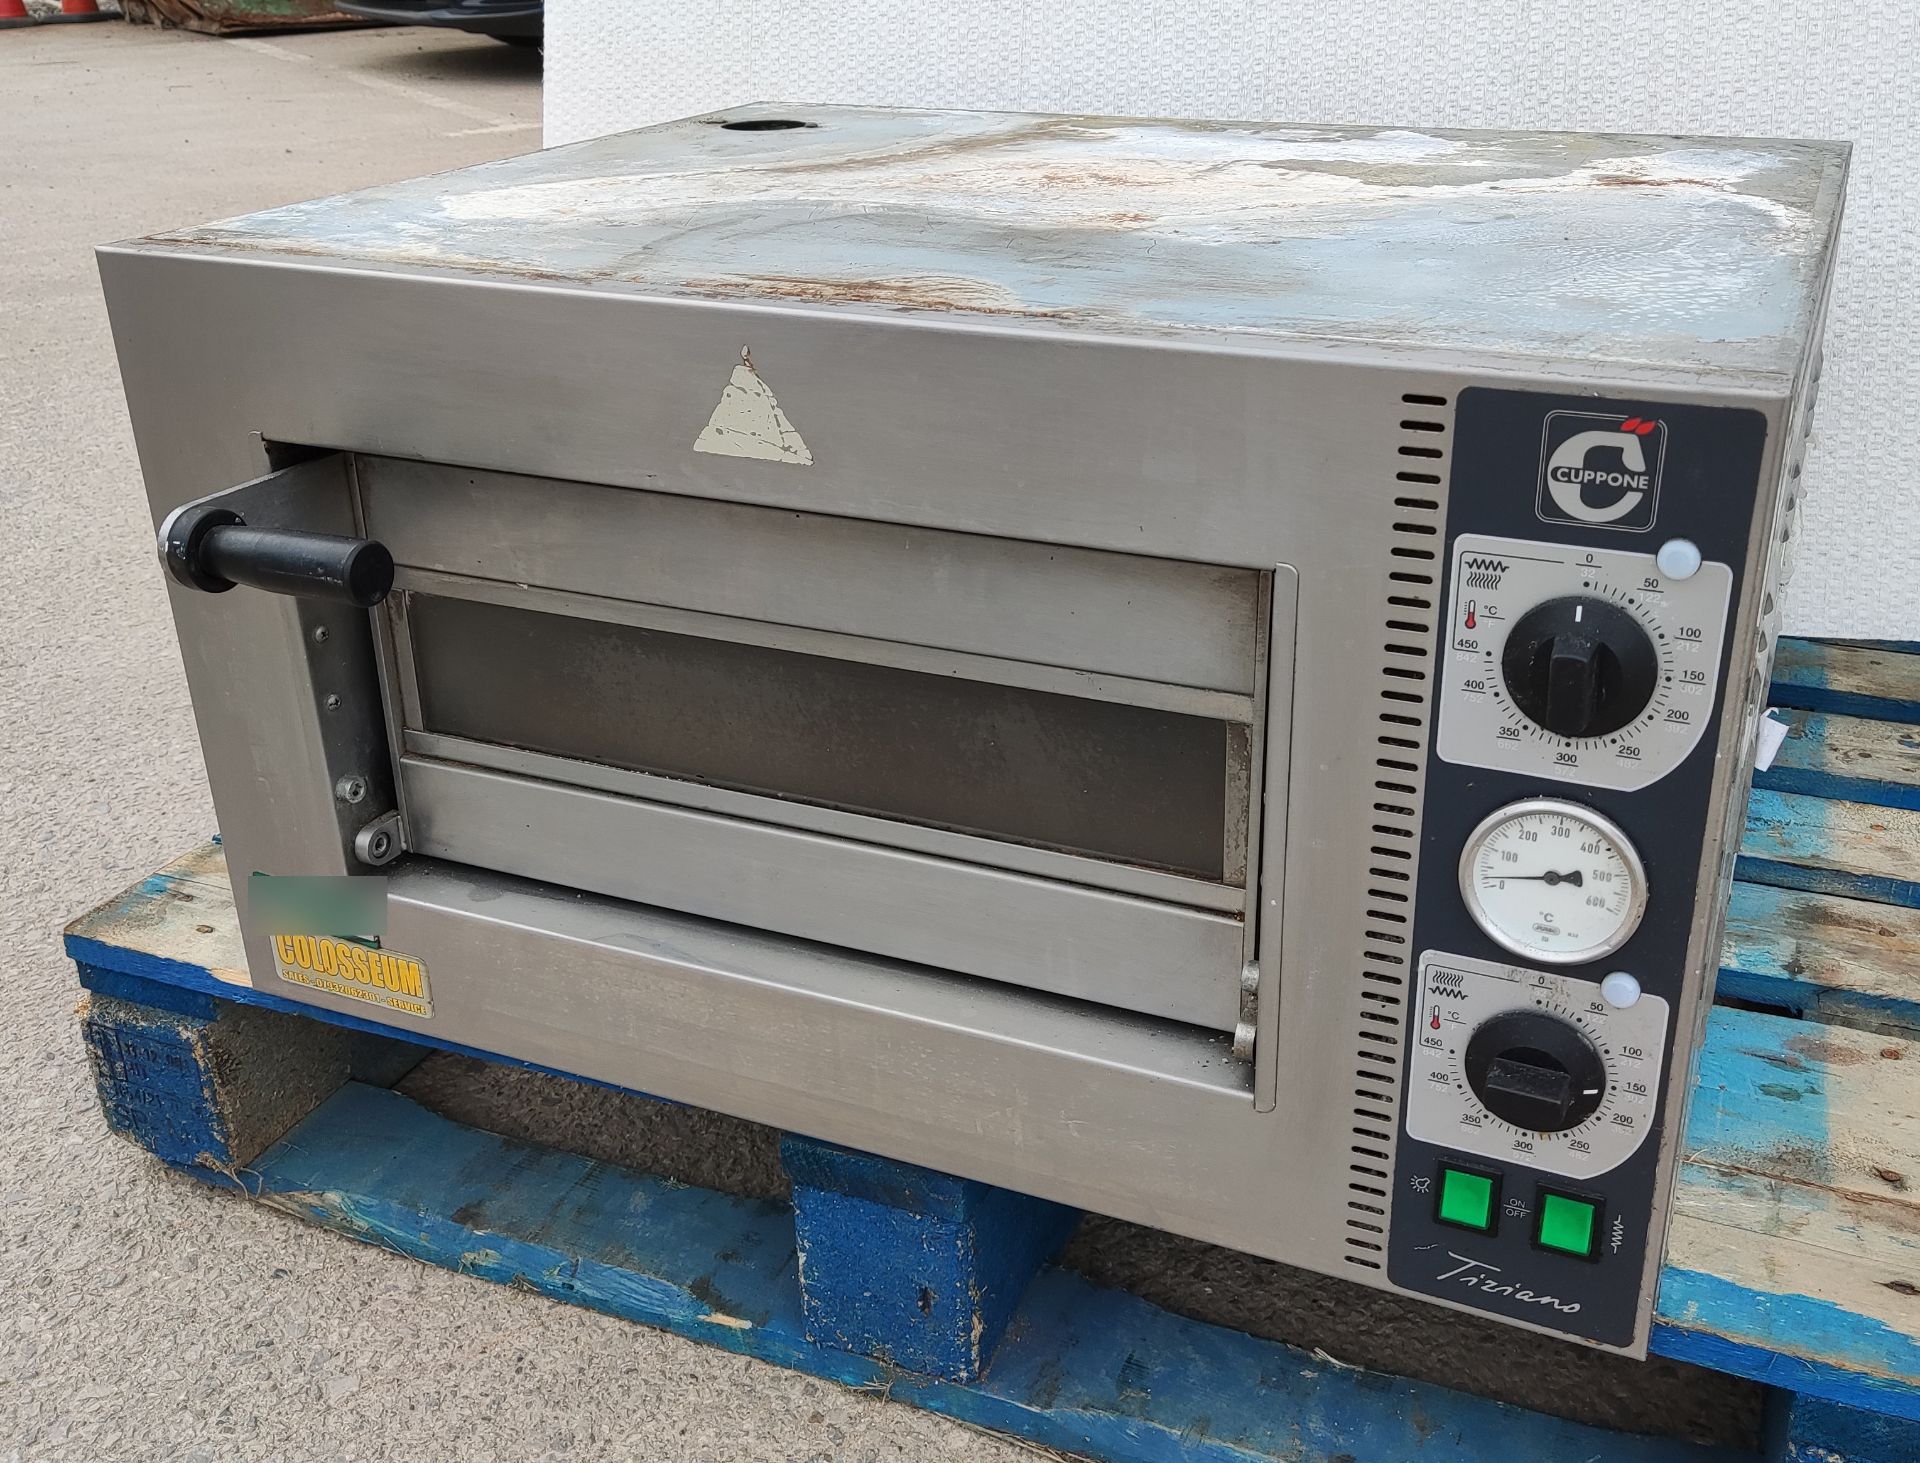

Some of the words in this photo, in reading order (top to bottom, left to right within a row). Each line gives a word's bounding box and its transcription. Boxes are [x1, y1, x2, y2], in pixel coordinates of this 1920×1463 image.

[1557, 468, 1649, 489] CUPPONE
[1586, 553, 1594, 563] 0
[1580, 568, 1597, 578] 32
[1643, 578, 1659, 588] 50
[1640, 592, 1660, 603] 122
[1484, 605, 1498, 615] °C
[1679, 627, 1702, 638] 100
[1457, 639, 1478, 649] 450
[1676, 641, 1700, 653] 212
[1456, 652, 1477, 663] 842
[1682, 670, 1705, 681] 150
[1464, 680, 1485, 690] 400
[1463, 692, 1484, 704] 752
[1667, 709, 1689, 720] 200
[1499, 727, 1520, 737] 350
[1618, 745, 1640, 756] 250
[1556, 752, 1577, 763] 300
[1518, 830, 1538, 842] 200
[1551, 826, 1570, 838] 300
[1580, 842, 1600, 855] 400
[1501, 851, 1518, 863] 100
[1592, 870, 1612, 882] 500
[1499, 880, 1505, 890] 0
[1586, 895, 1606, 909] 600
[1539, 911, 1554, 923] °C
[276, 935, 424, 999] COLOSSEUM
[1538, 976, 1545, 985] 0
[282, 969, 309, 985] SALES
[387, 997, 427, 1015] SERVICE
[1590, 1002, 1604, 1012] 50
[1447, 1010, 1460, 1020] °C
[1424, 1037, 1443, 1047] 450
[1622, 1046, 1642, 1057] 100
[1430, 1071, 1449, 1081] 400
[1626, 1081, 1647, 1093] 150
[1462, 1113, 1481, 1124] 350
[1613, 1113, 1633, 1124] 200
[1514, 1140, 1533, 1151] 300
[1569, 1139, 1590, 1150] 250
[1509, 1198, 1526, 1209] ON
[1505, 1208, 1527, 1219] OFF
[1436, 1250, 1581, 1313] Tiziano
